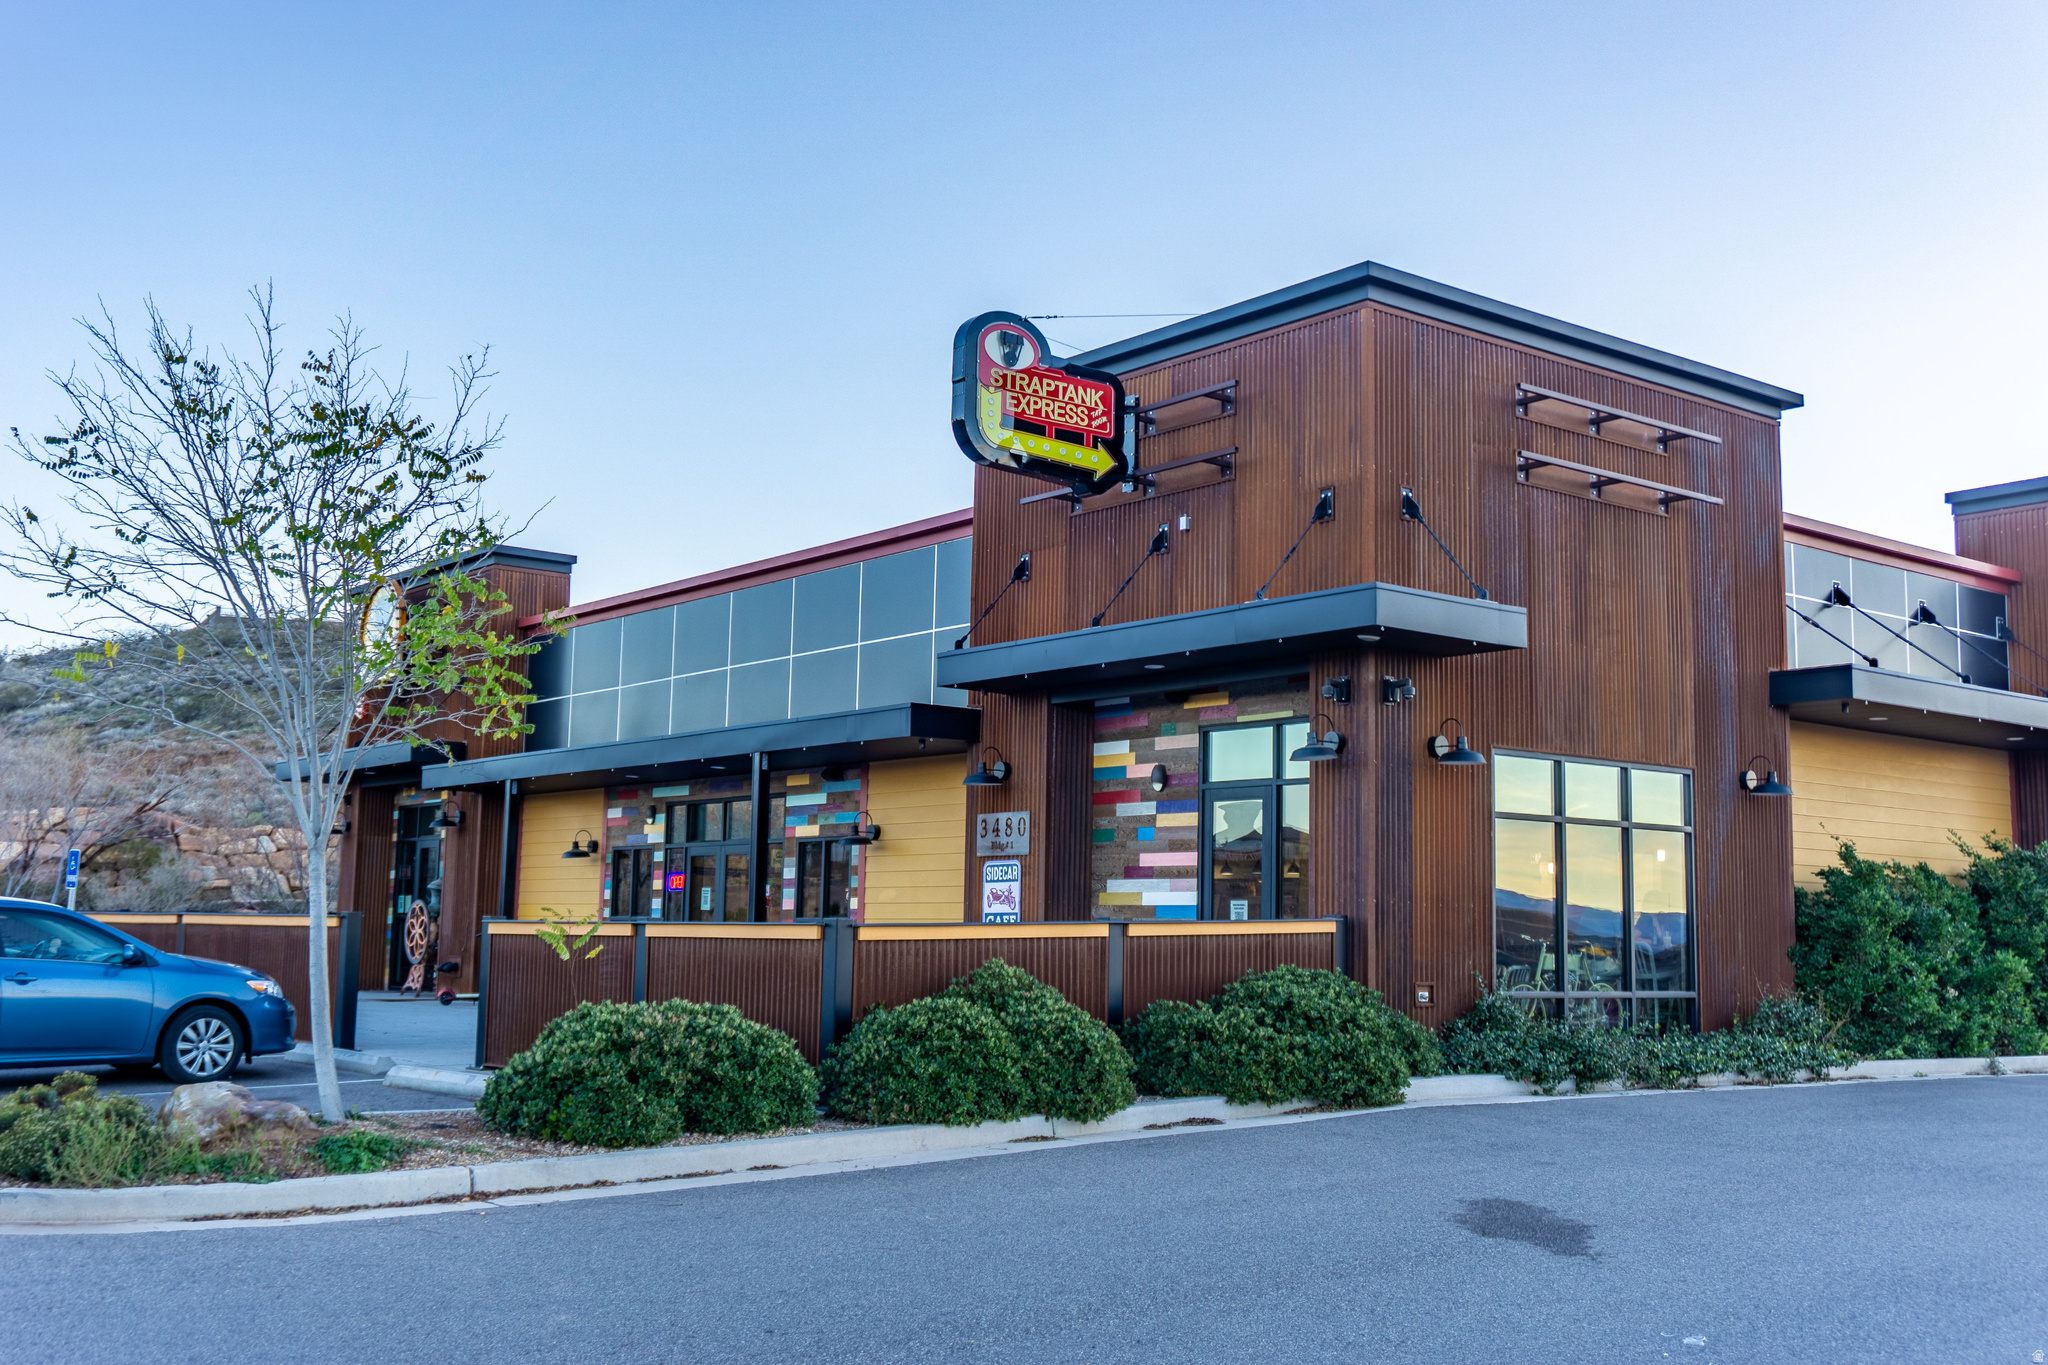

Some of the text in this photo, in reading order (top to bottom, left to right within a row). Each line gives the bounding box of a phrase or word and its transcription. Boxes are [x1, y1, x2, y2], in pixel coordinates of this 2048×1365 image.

[990, 367, 1104, 410] STRAPTANK
[1005, 392, 1089, 427] EXPRESS
[1090, 409, 1102, 419] TAP
[1091, 416, 1108, 429] ROOM
[980, 816, 1027, 839] 3480
[986, 866, 1018, 881] SIDECAR
